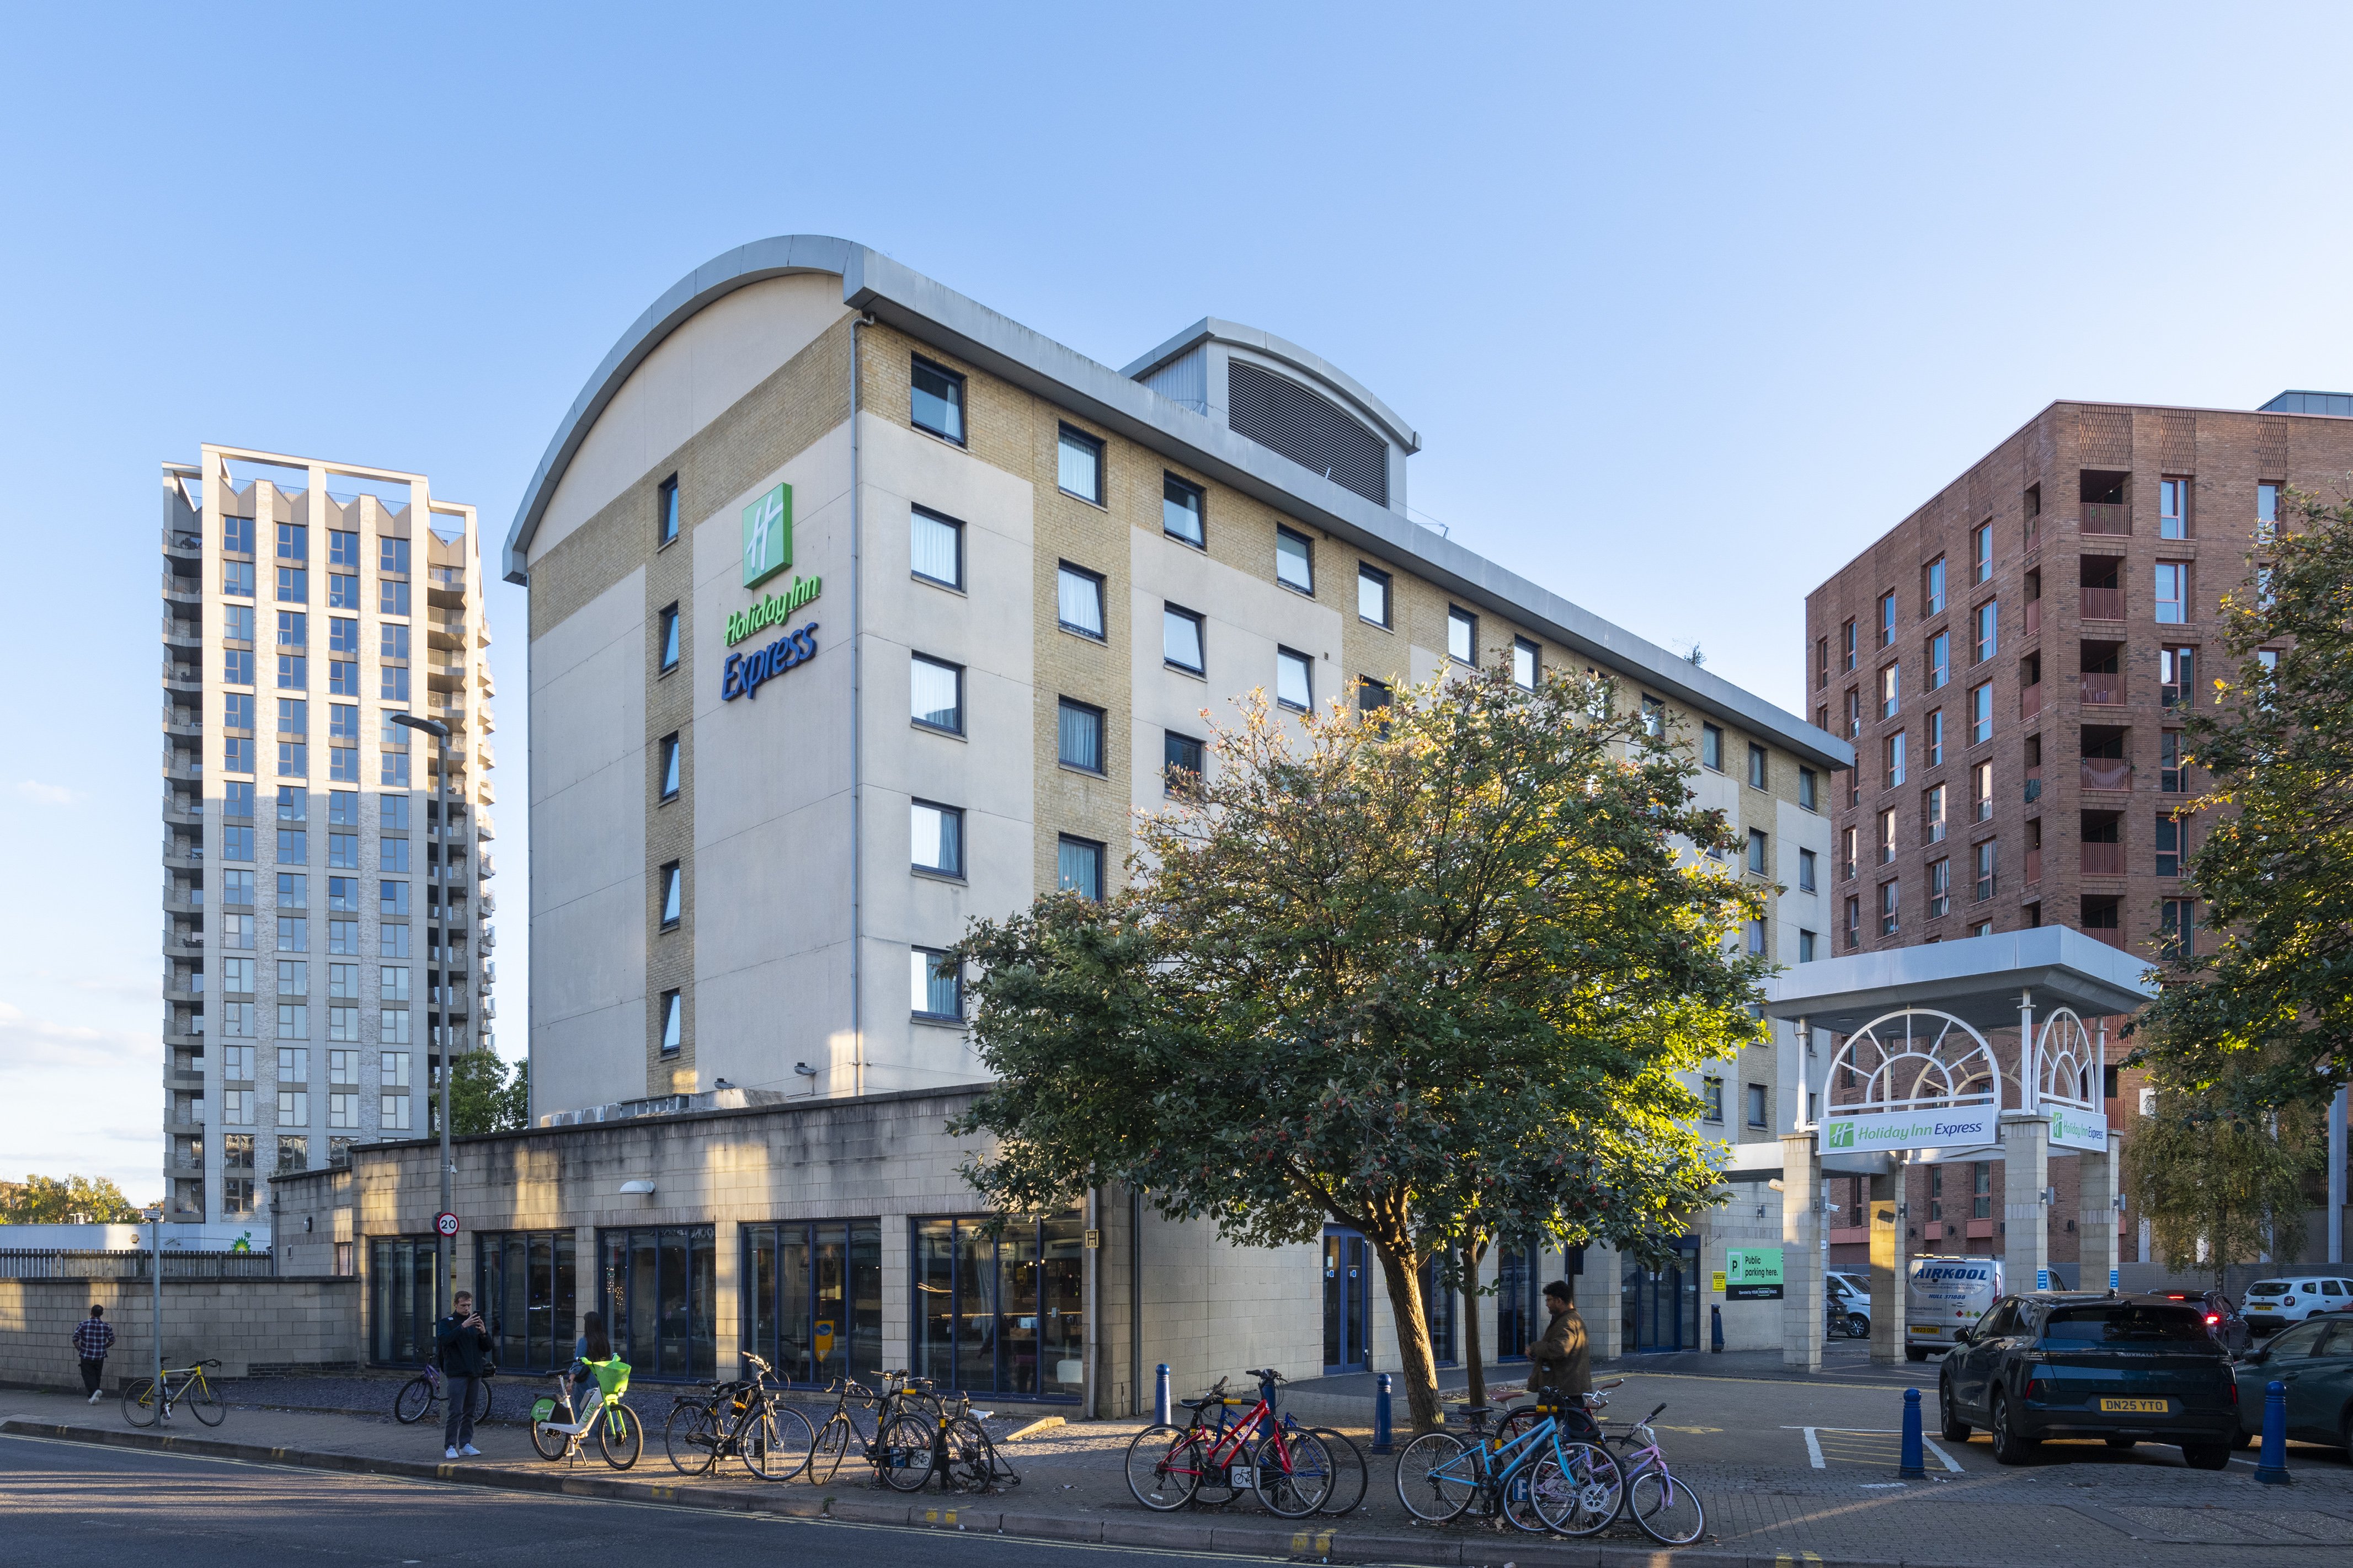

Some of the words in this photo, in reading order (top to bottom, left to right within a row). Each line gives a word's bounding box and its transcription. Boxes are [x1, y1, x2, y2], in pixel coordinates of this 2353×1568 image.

[724, 592, 789, 646] Holiday
[789, 575, 821, 610] Inn
[721, 622, 819, 700] Express
[1858, 1125, 1908, 1140] Holiday
[1911, 1123, 1932, 1136] Inn
[1935, 1122, 1982, 1137] Express
[2063, 1120, 2080, 1138] Holiday
[2088, 1127, 2103, 1141] Express
[441, 1219, 456, 1229] 20
[244, 1230, 251, 1239] bp
[1086, 1231, 1097, 1246] H
[1732, 1260, 1738, 1272] P
[1745, 1256, 1761, 1264] Public
[1745, 1268, 1764, 1278] parking
[1914, 1269, 1987, 1280] AIRKOOL
[2106, 1400, 2137, 1410] DN25
[2139, 1401, 2163, 1411] YTO
[581, 1403, 596, 1423] Lime
[1239, 1416, 1260, 1444] CHALLENGE
